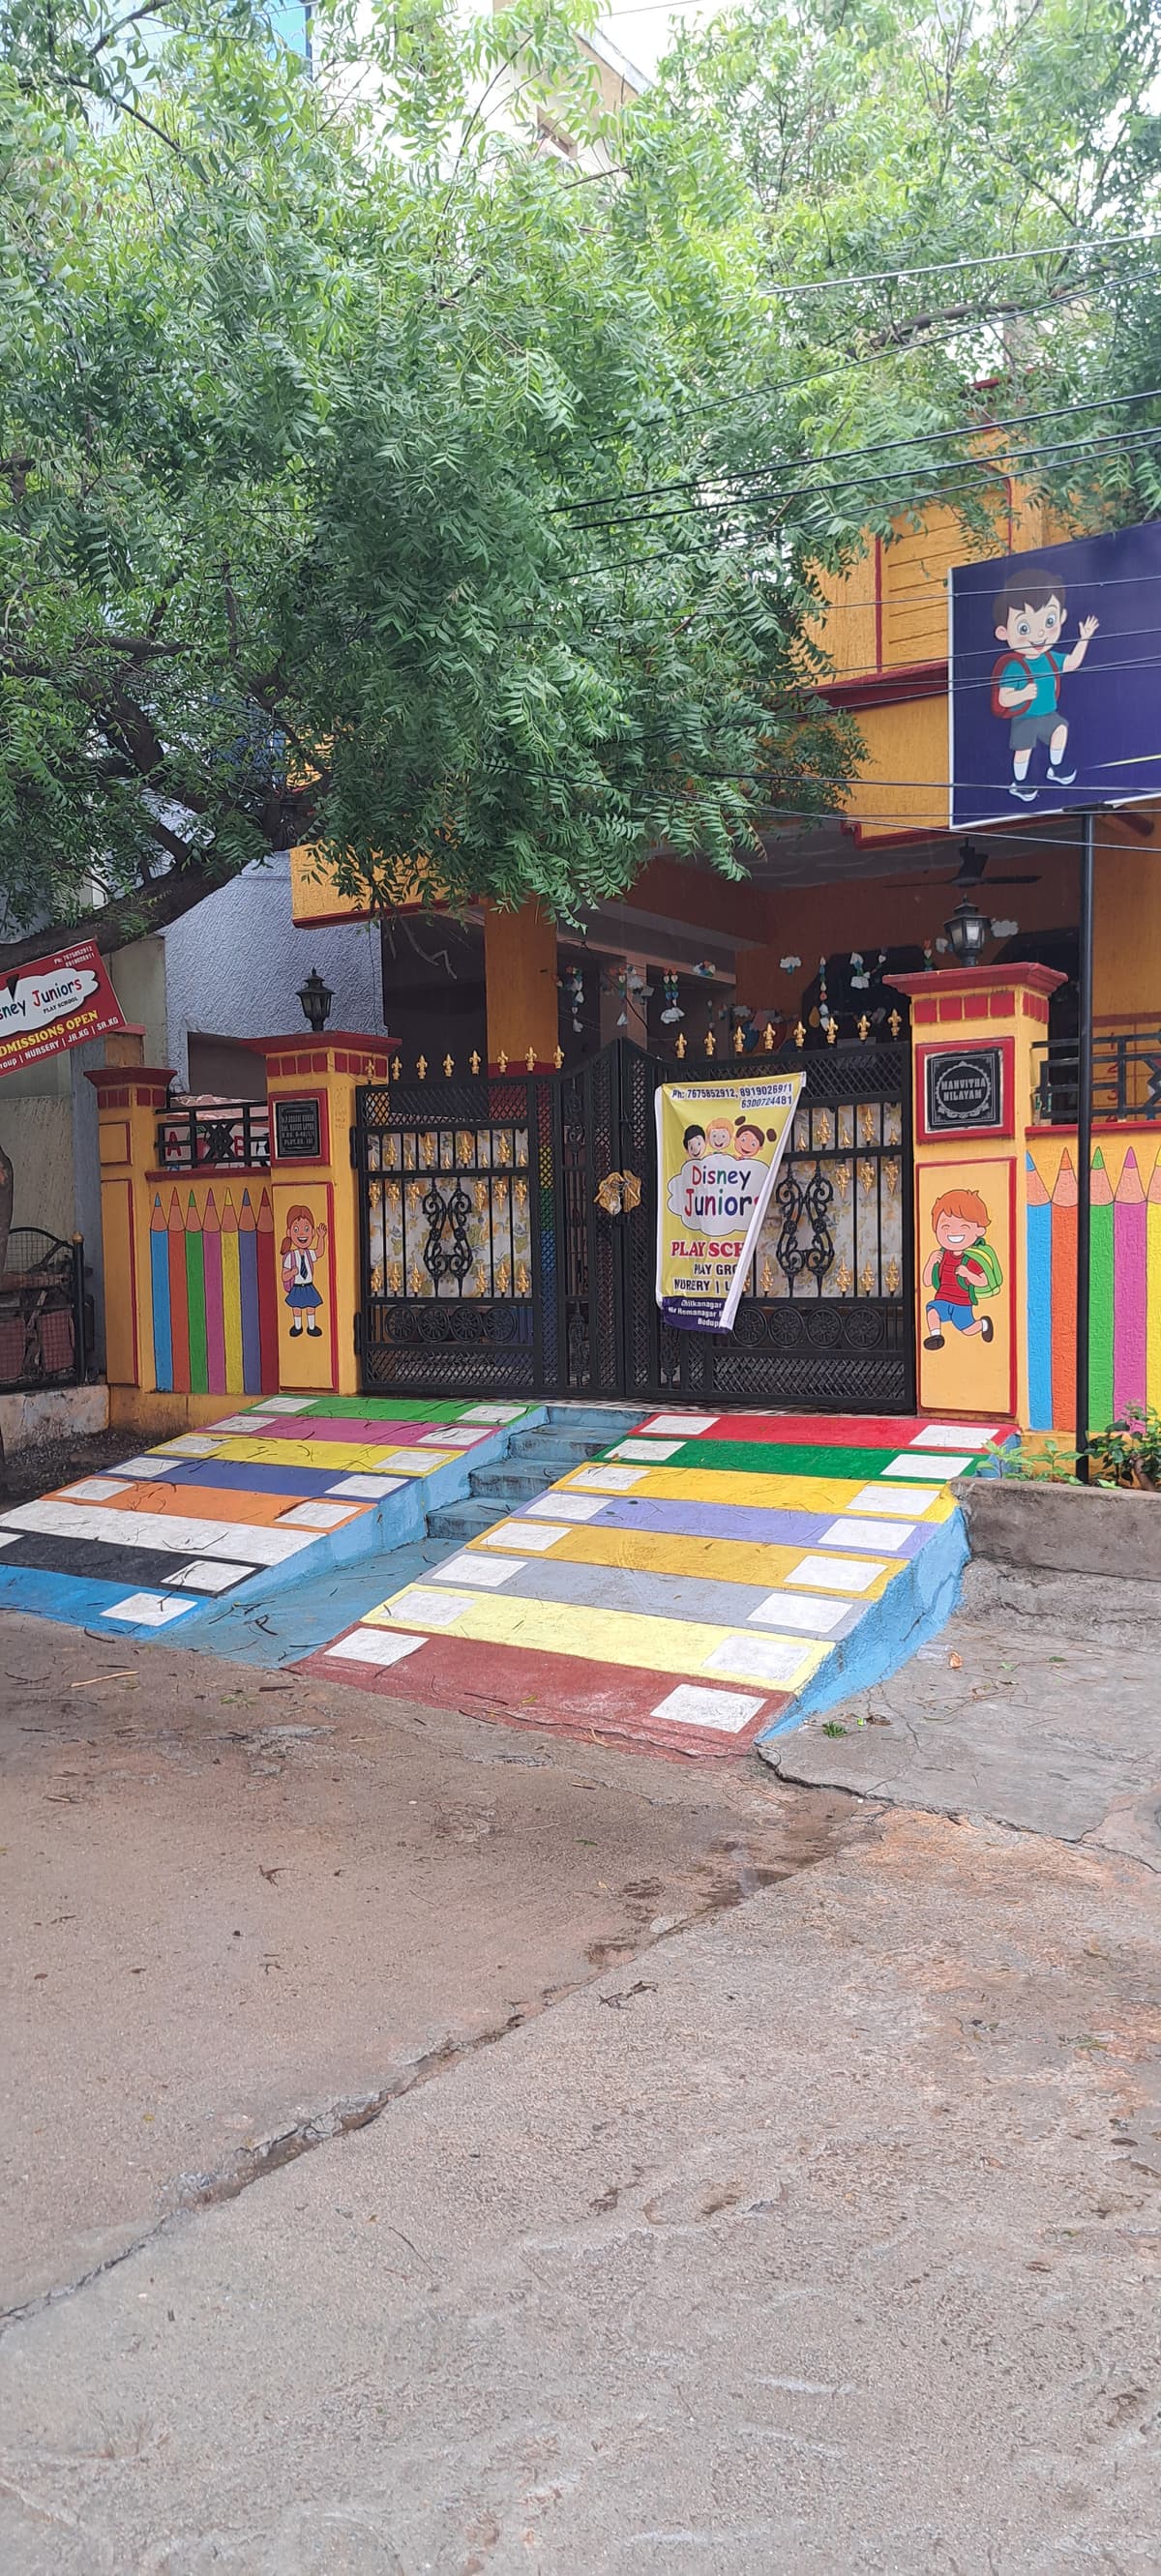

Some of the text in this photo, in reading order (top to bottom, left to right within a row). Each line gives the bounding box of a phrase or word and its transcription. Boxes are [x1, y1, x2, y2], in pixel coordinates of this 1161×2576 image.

[32, 978, 83, 1007] Juniors
[43, 996, 79, 1015] PLAY SCHOOL
[66, 1010, 99, 1031] OPEN
[24, 1041, 60, 1060] NURSERY
[68, 1027, 90, 1044] JR.KG
[97, 1016, 119, 1031] SR.KG
[671, 1089, 685, 1099] Ph:
[941, 1078, 987, 1091] MANVITHA
[943, 1089, 983, 1102] NILAYAM
[692, 1165, 752, 1191] Disney
[670, 1241, 706, 1257] PLAY
